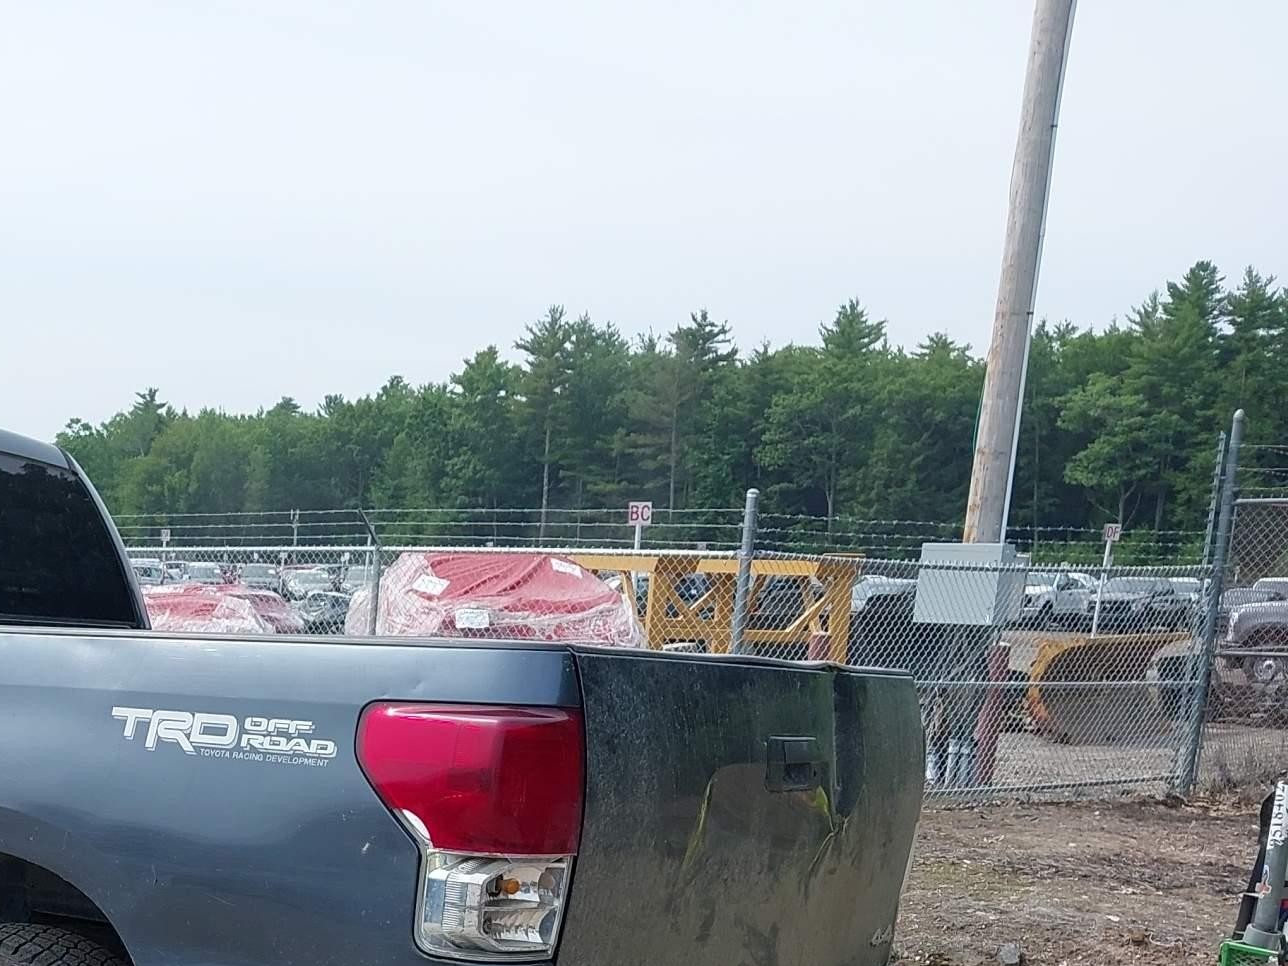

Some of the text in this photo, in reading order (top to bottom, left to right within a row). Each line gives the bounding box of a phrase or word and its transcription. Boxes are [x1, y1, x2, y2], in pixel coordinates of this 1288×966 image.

[630, 504, 650, 522] BC
[1107, 526, 1120, 539] DF
[111, 706, 239, 755] TRD
[243, 716, 316, 736] OFF
[240, 733, 338, 758] ROAD
[199, 748, 330, 768] TOYOTA RACING DEVELOPMENT
